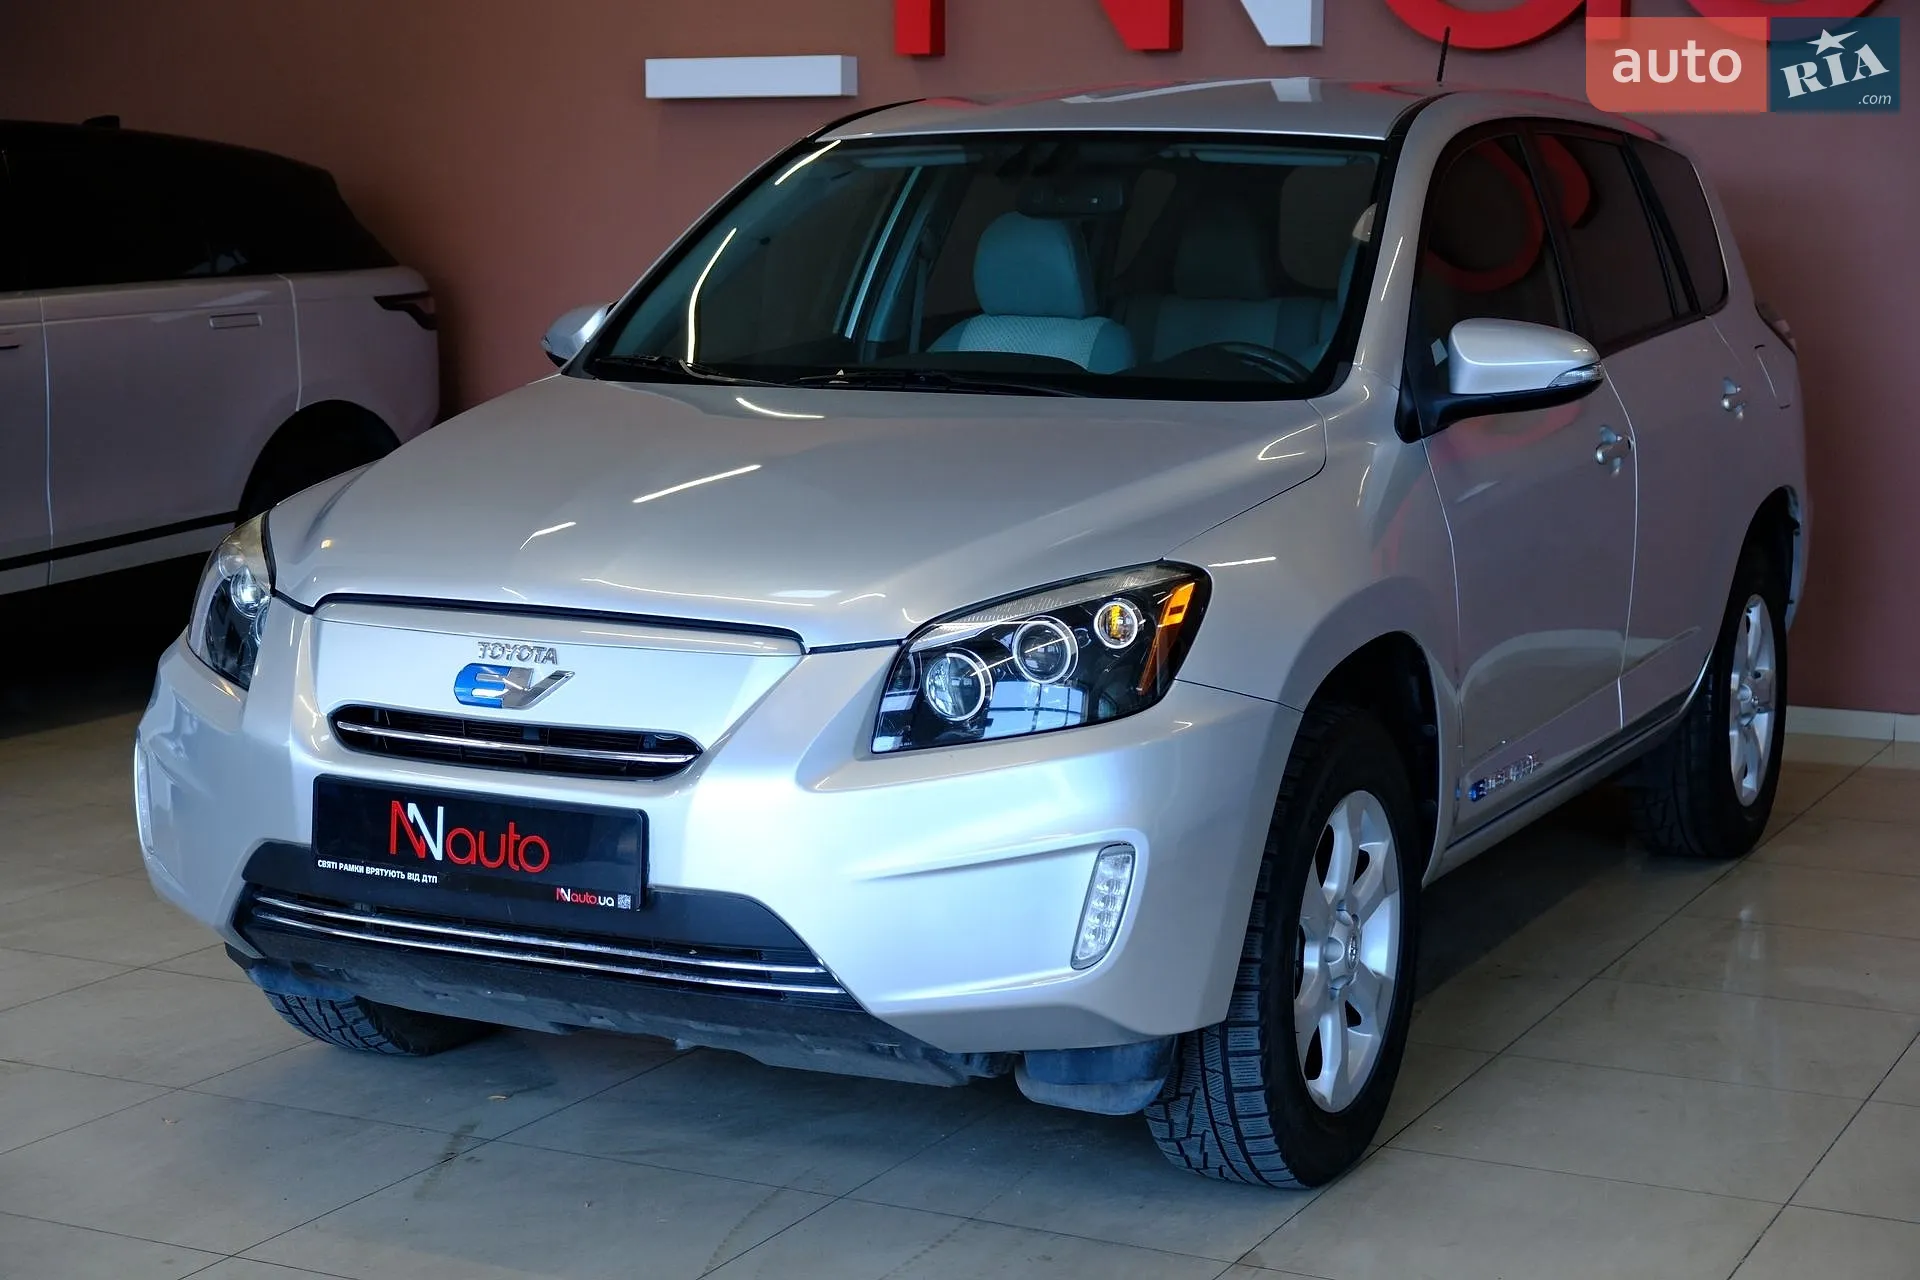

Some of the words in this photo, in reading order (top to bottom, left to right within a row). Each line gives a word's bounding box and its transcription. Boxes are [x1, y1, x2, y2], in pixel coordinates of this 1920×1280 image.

[477, 641, 559, 666] TOYOTA
[317, 859, 338, 870] СВЯТІ
[339, 862, 365, 874] РАМКИ
[365, 866, 406, 880] ВРЯТУЮТЬ
[407, 872, 421, 883] ВІД
[421, 874, 438, 884] ДТП
